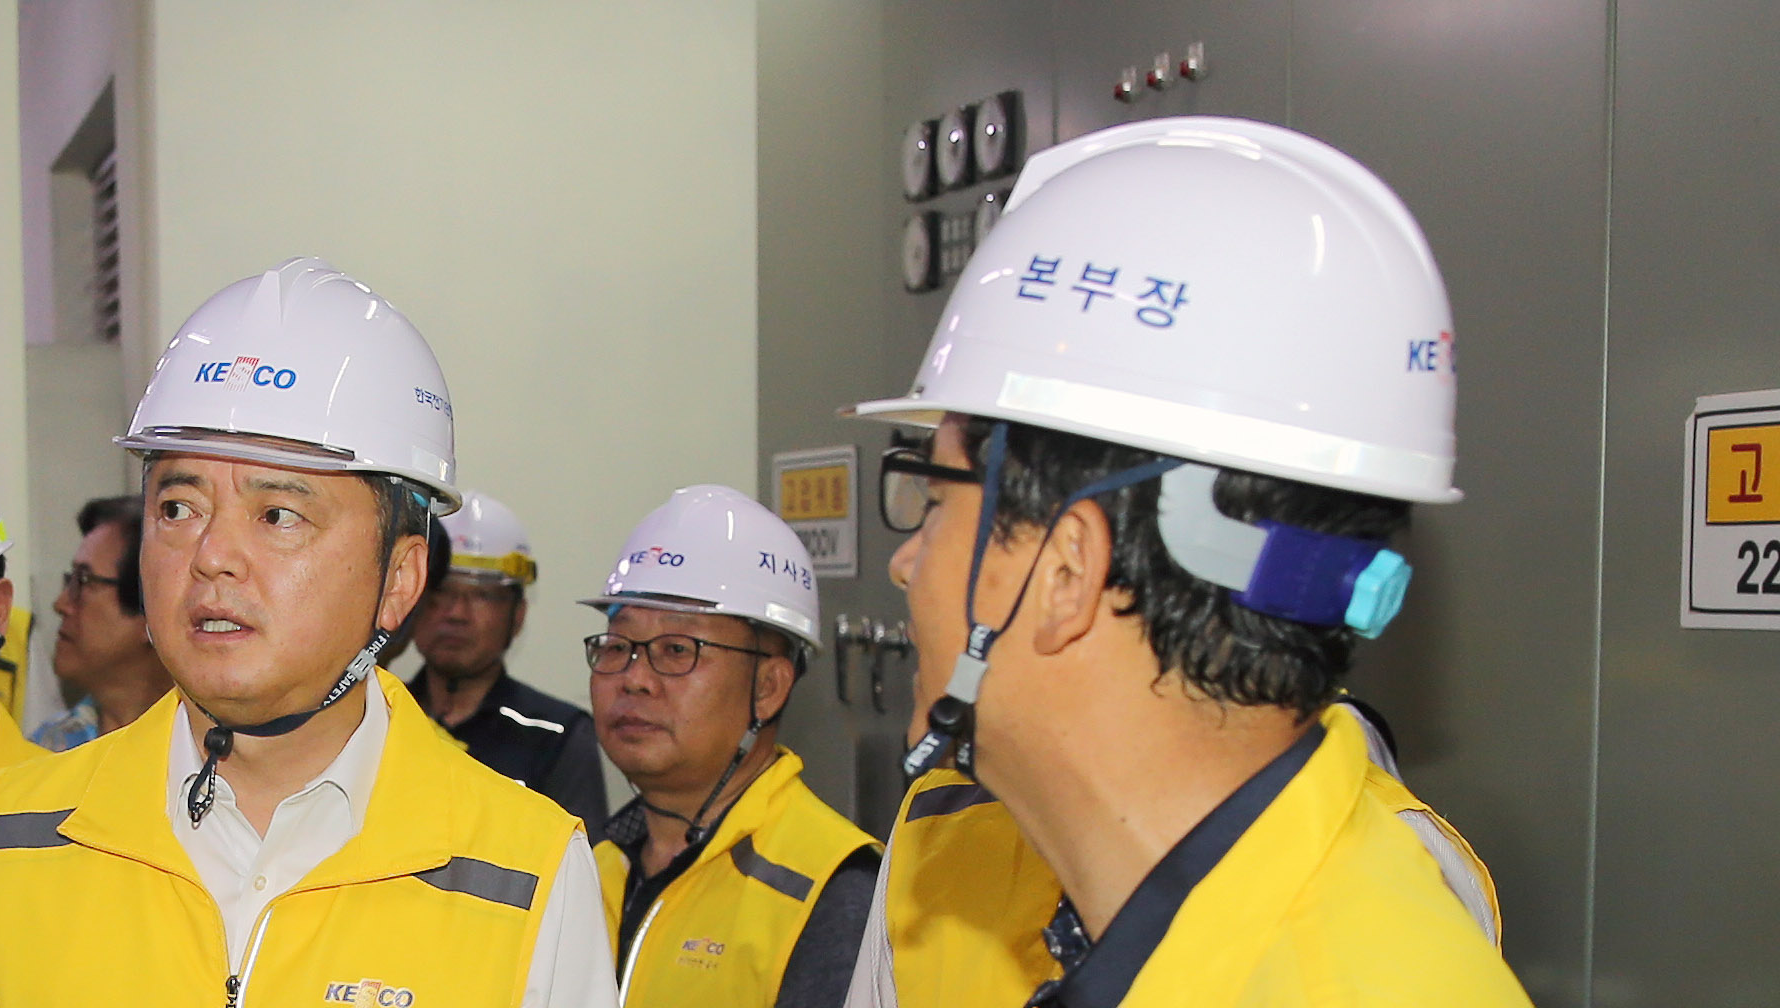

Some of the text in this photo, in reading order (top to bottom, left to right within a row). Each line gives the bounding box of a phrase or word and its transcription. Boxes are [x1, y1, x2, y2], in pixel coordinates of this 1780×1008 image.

[1018, 254, 1189, 328] 본부장
[194, 356, 297, 393] KESCO
[1727, 443, 1763, 503] 고
[759, 551, 812, 591] 지사장
